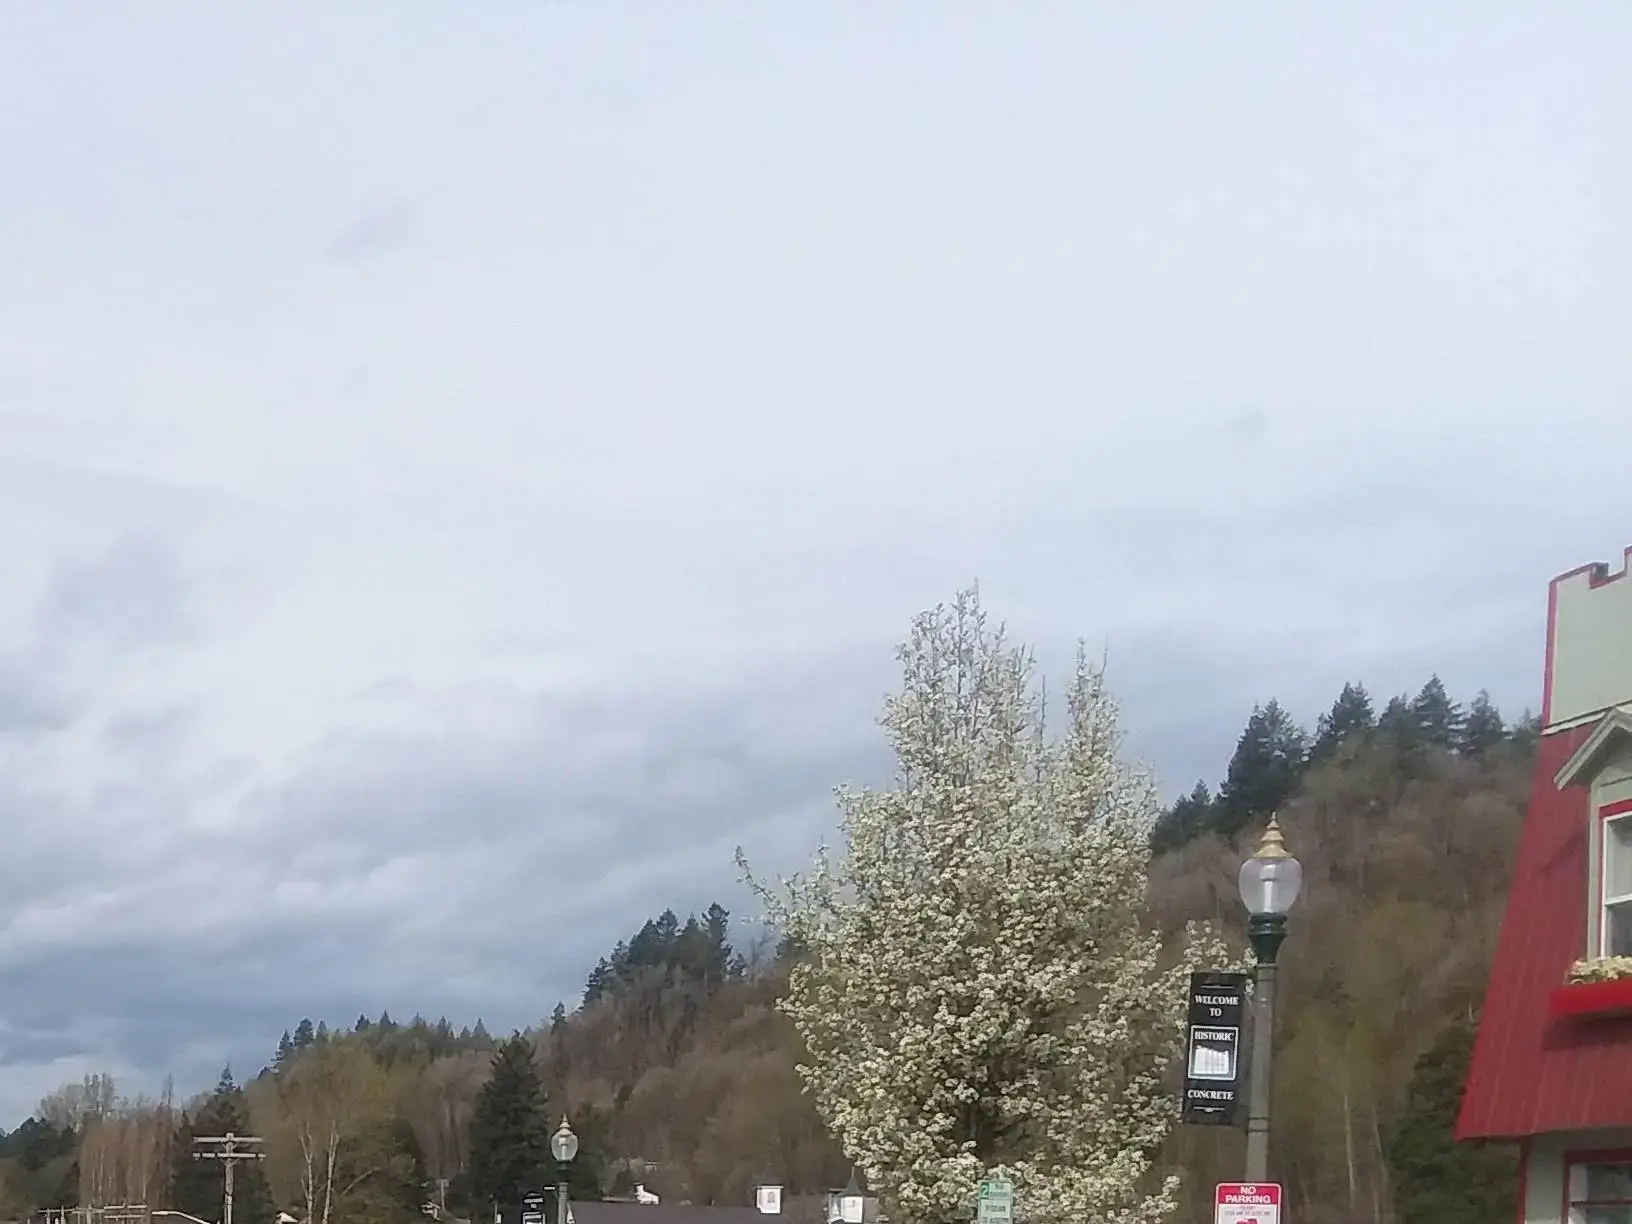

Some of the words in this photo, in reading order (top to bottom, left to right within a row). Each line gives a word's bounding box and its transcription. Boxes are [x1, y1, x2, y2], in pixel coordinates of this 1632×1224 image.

[1194, 995, 1239, 1006] WELCOME
[1209, 1007, 1222, 1017] TO
[1194, 1031, 1235, 1041] HISTORIC
[1187, 1089, 1235, 1101] CONCRETE
[1240, 1186, 1257, 1195] NO
[1225, 1194, 1271, 1204] PARKING
